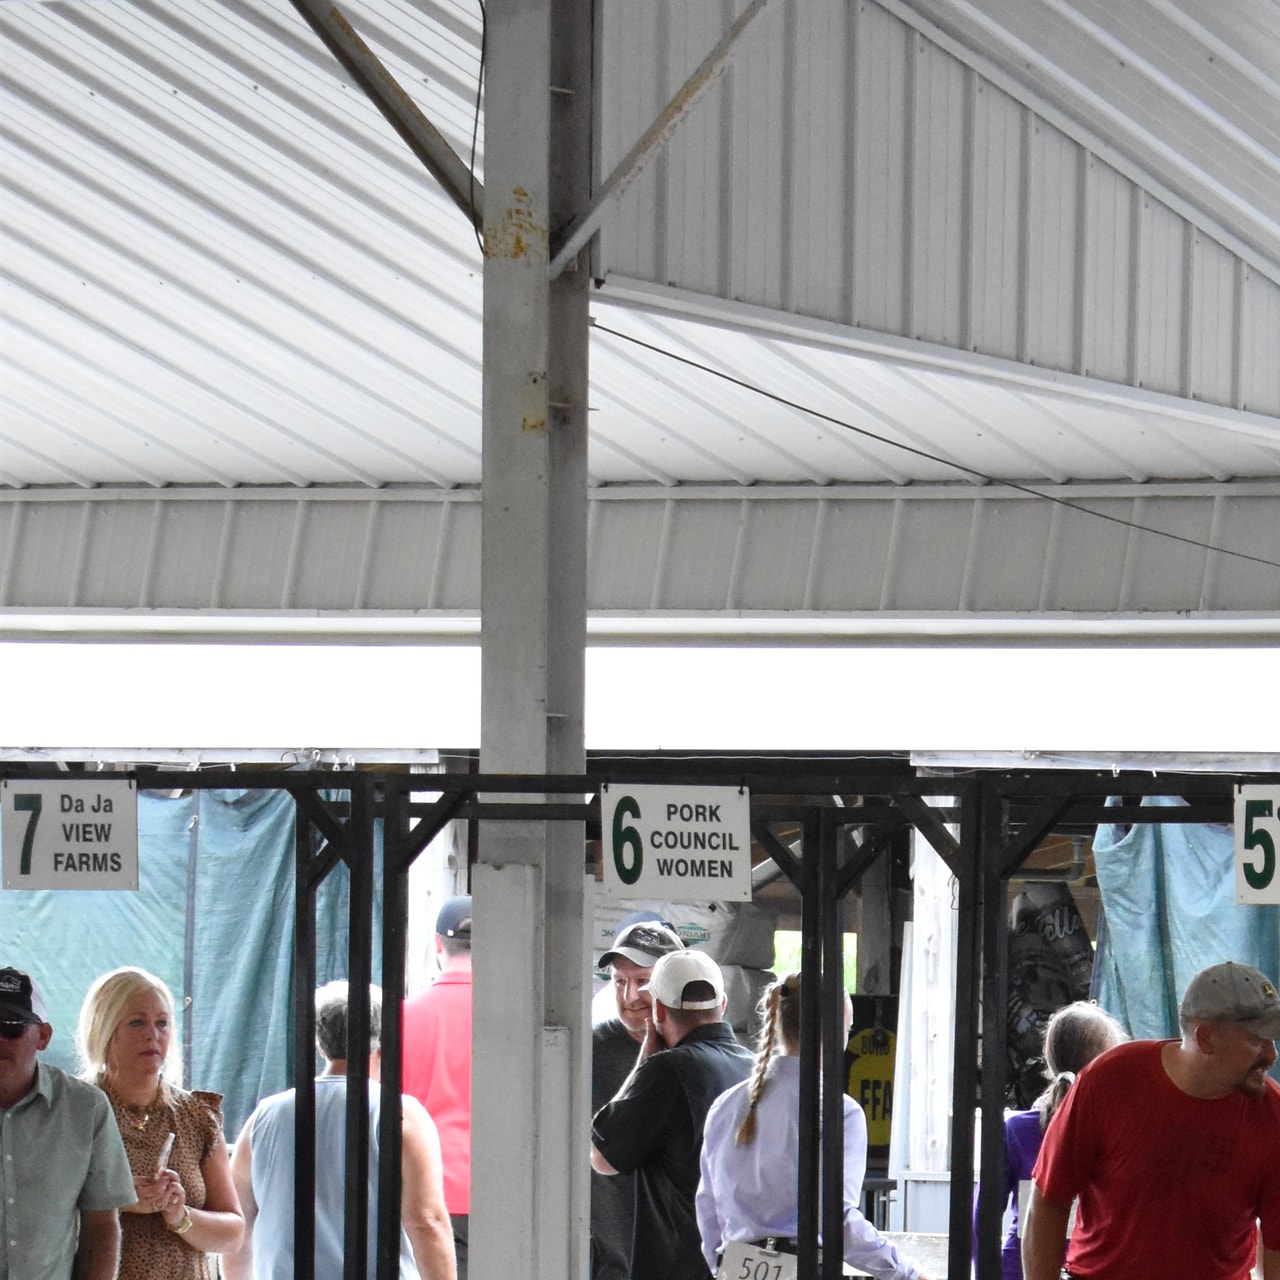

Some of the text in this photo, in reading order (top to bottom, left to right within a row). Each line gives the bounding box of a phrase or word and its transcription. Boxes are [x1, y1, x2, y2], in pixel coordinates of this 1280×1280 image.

[60, 794, 114, 813] Da Ja
[667, 803, 722, 823] PORK
[14, 793, 42, 875] 7
[62, 823, 112, 842] VIEW
[612, 795, 644, 886] 6
[650, 830, 740, 851] COUNCIL
[1242, 799, 1276, 890] 5
[53, 852, 122, 872] FARMS
[656, 858, 733, 878] WOMEN
[860, 1079, 892, 1121] FFA
